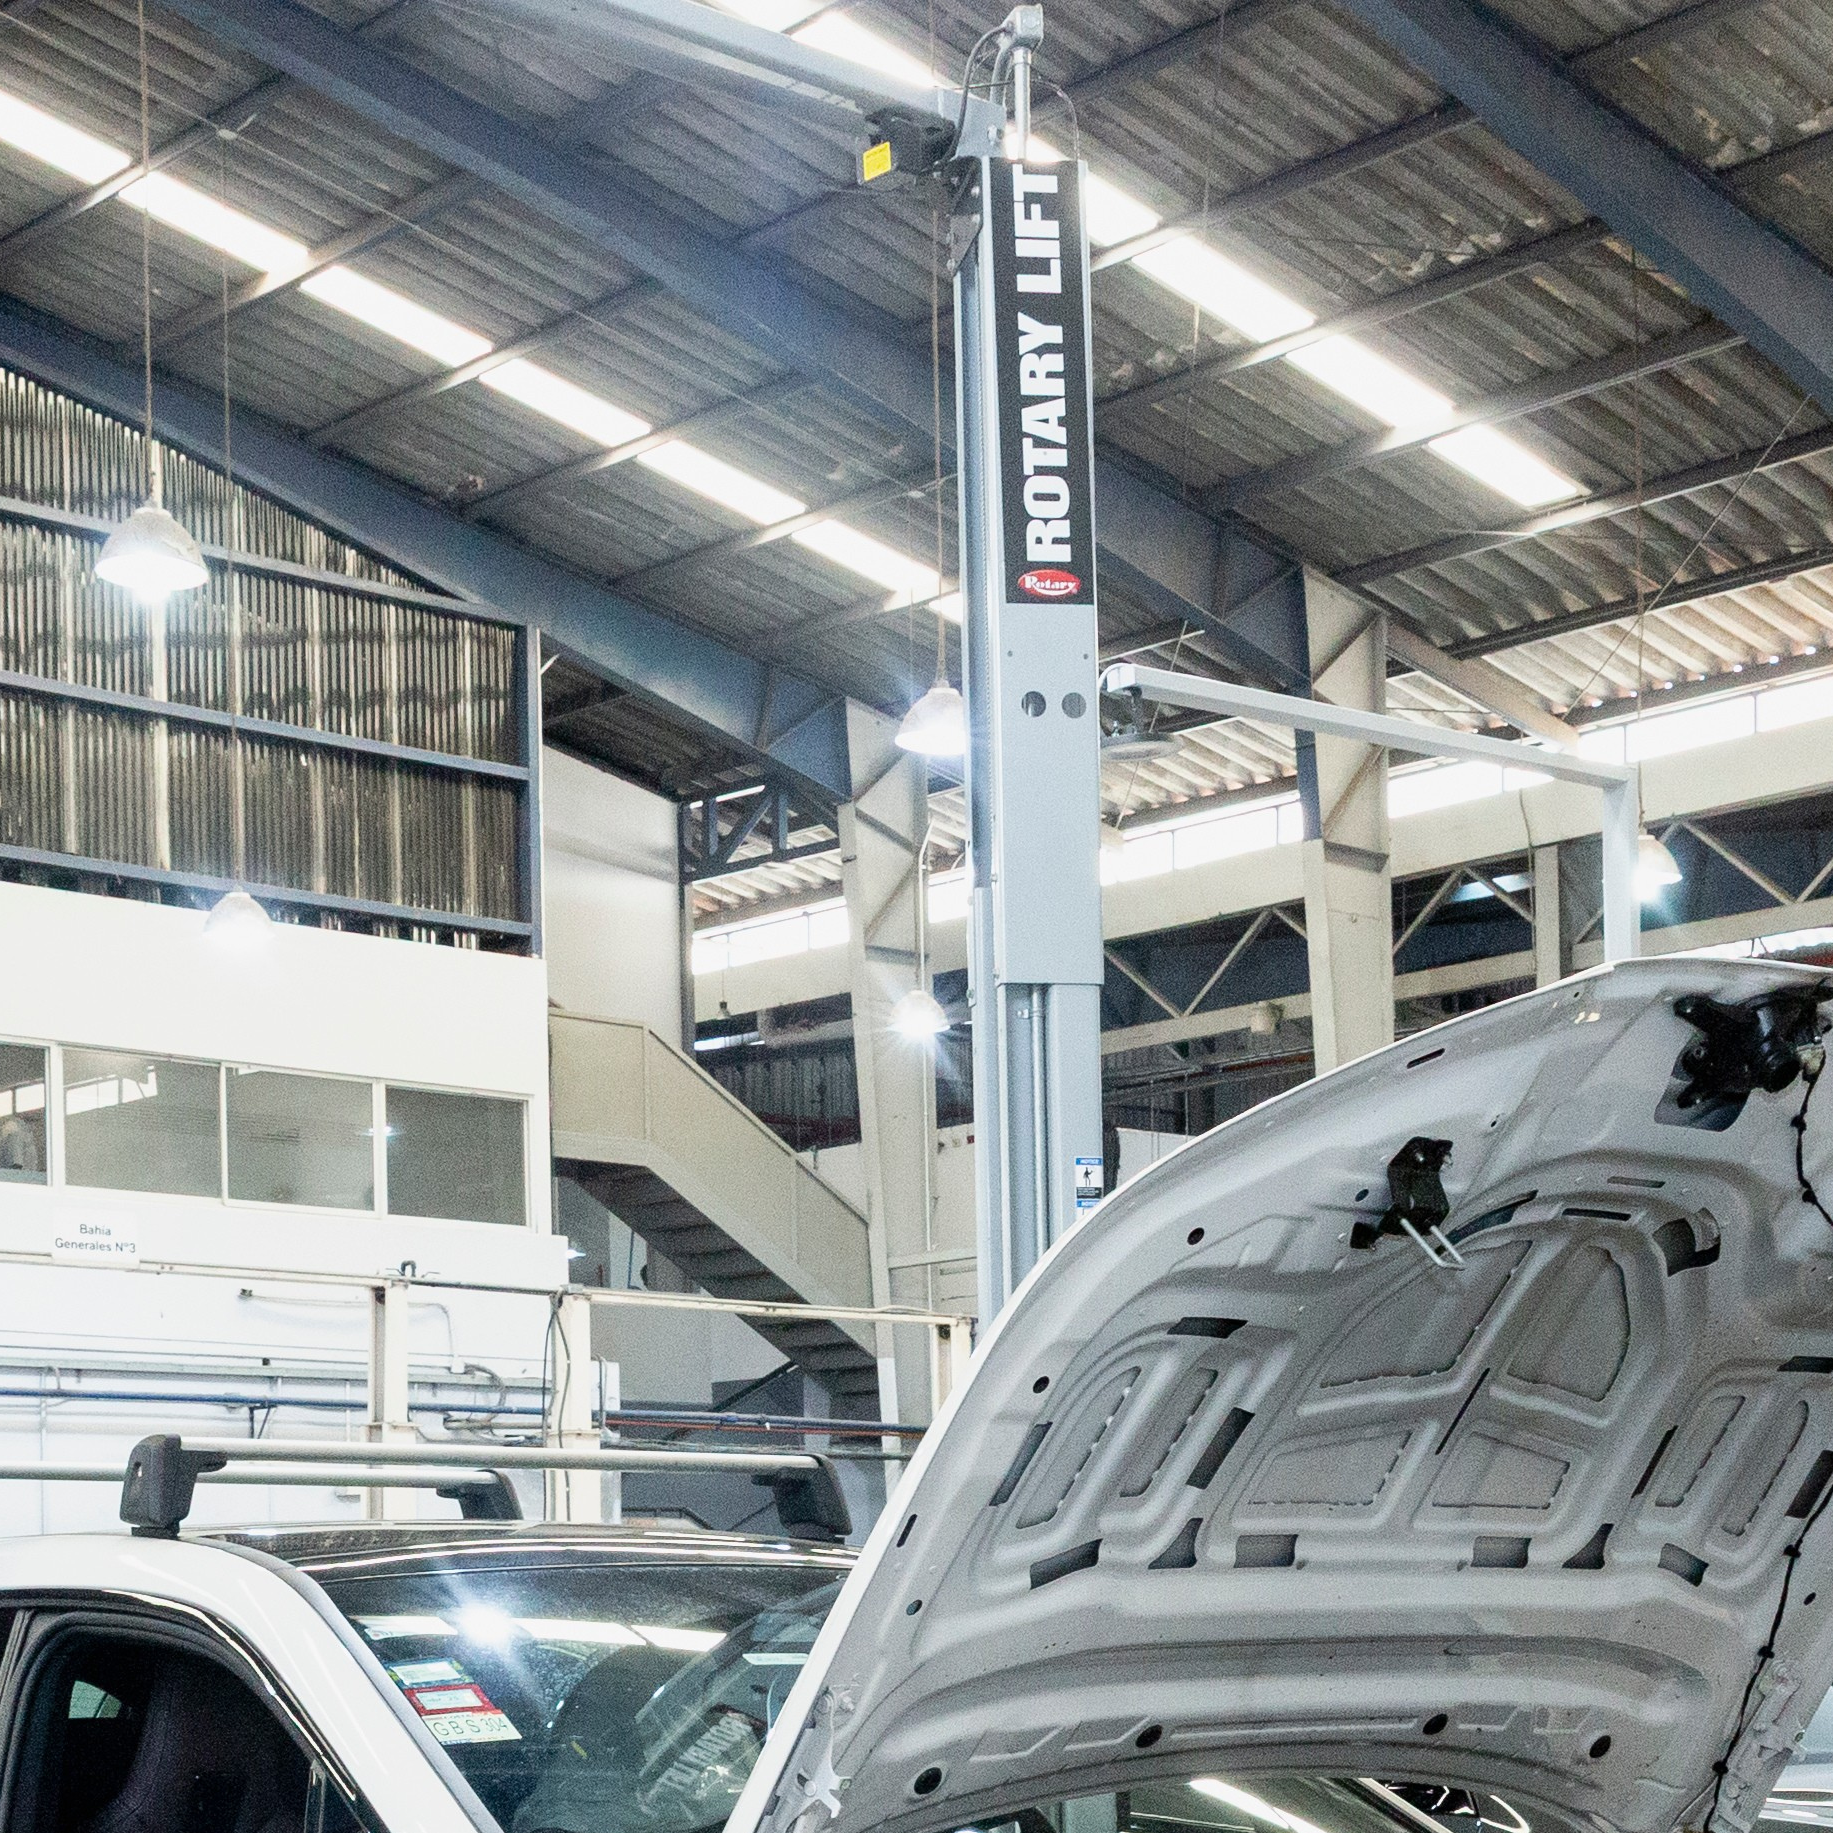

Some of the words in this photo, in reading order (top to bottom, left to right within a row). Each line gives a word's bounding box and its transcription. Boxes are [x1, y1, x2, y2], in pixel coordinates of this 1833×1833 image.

[1012, 163, 1062, 294] LIFT
[1017, 311, 1072, 563] ROTARY
[1024, 575, 1077, 595] Rotary
[54, 1237, 112, 1252] Generales
